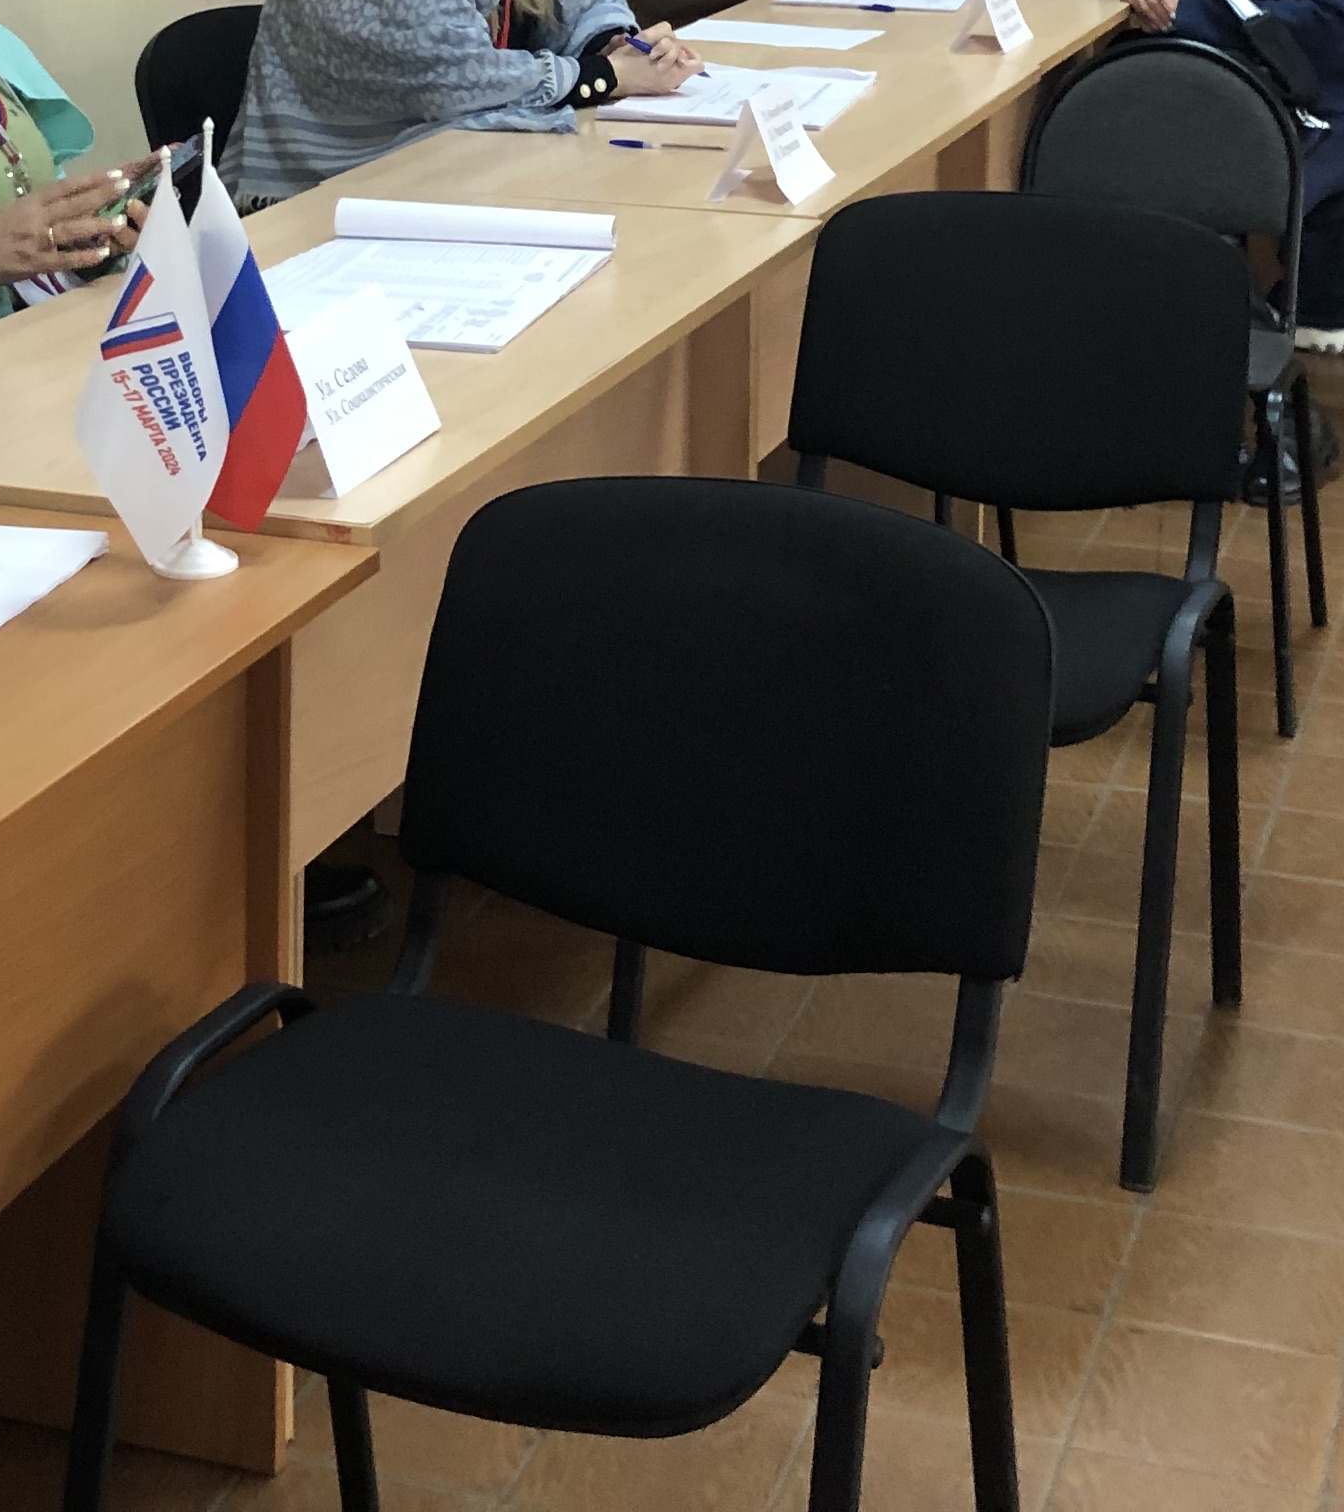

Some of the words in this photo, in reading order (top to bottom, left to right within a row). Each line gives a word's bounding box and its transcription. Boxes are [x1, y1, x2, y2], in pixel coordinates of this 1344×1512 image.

[132, 363, 182, 431] РОССИИ
[157, 357, 207, 462] ПРЕЗИДЕНТА
[178, 351, 208, 424] ВЫБОРЫ
[132, 404, 167, 447] МАРТА
[157, 446, 182, 477] 2024
